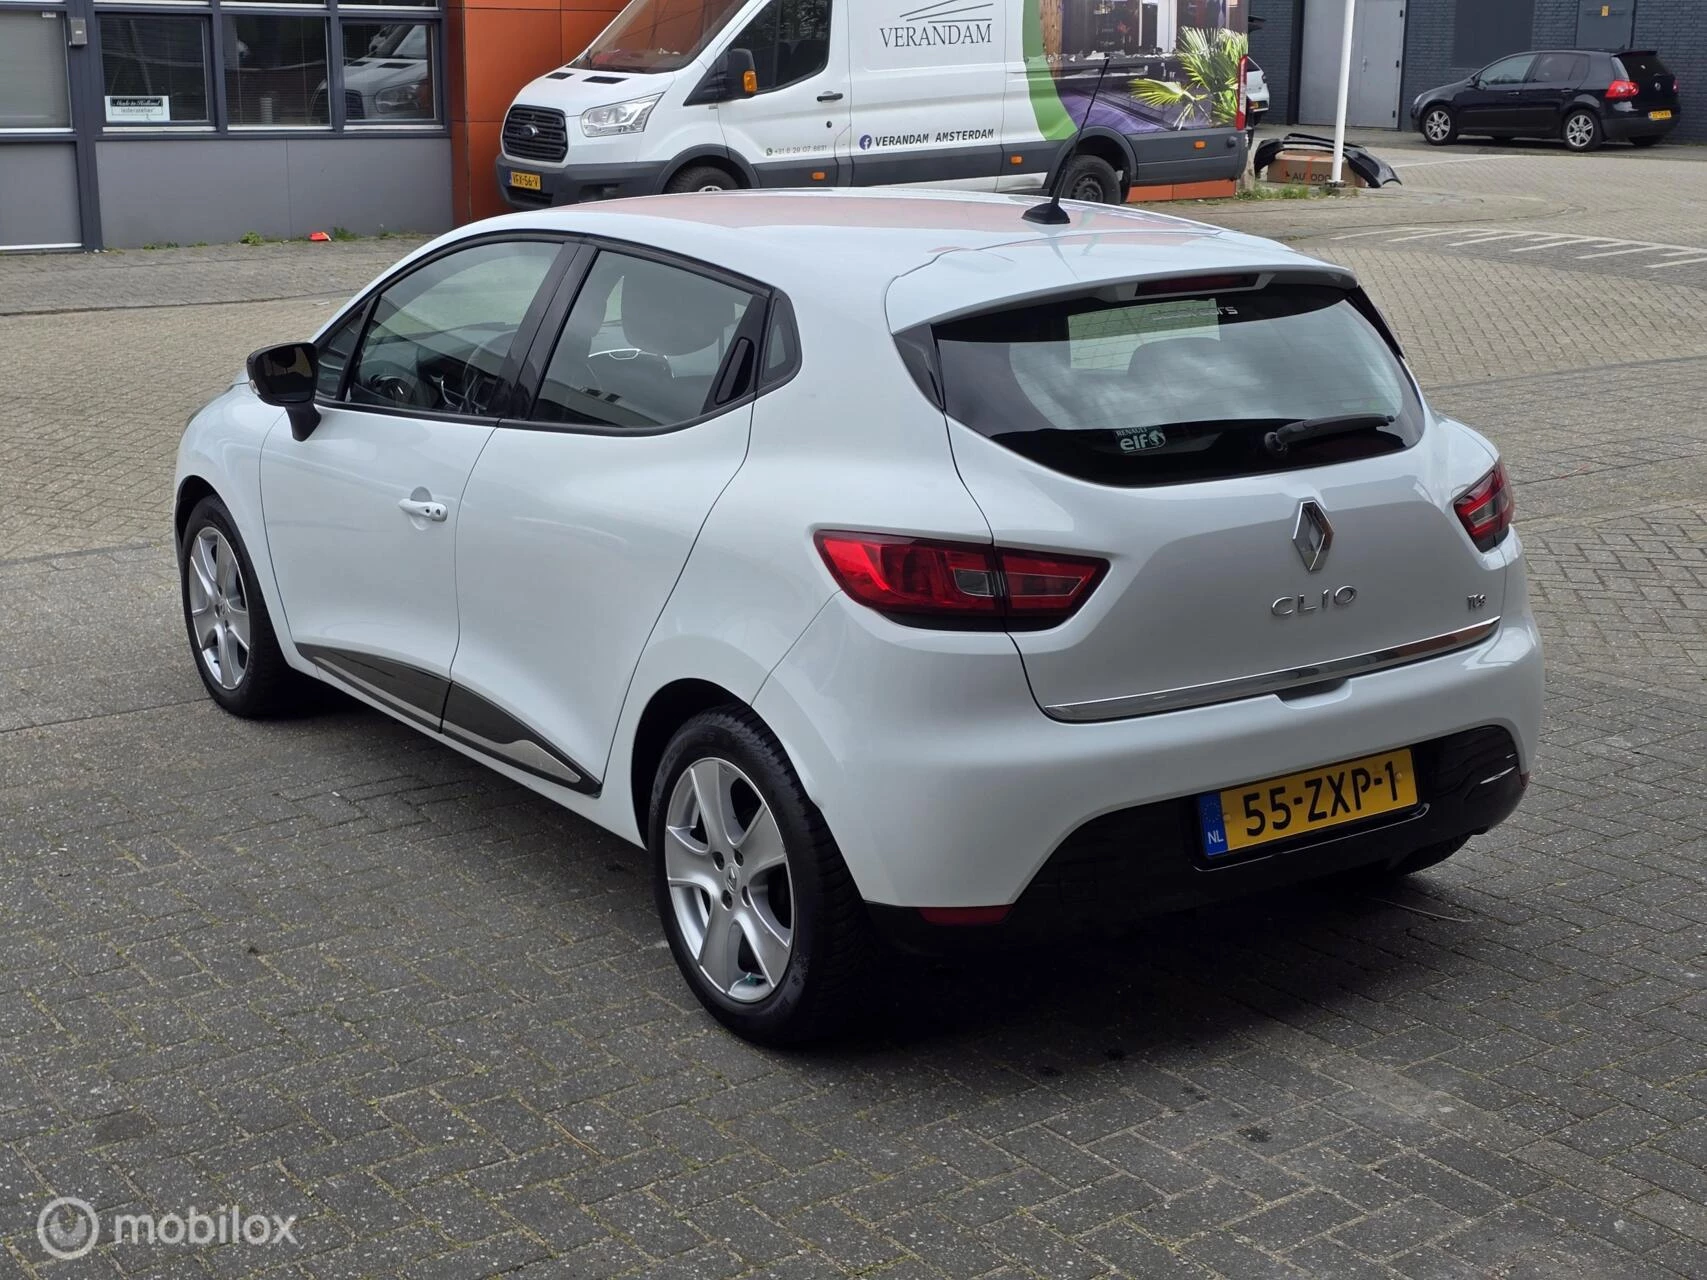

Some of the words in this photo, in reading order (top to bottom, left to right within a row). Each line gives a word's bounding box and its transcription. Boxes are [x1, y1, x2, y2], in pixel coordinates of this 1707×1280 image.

[880, 24, 992, 48] VERANDAM
[875, 133, 929, 147] VERANDAM
[935, 128, 994, 143] AMSTERDAM
[1120, 433, 1148, 451] elf
[1271, 585, 1358, 616] CLIO
[1242, 760, 1399, 837] 55-ZXP-1
[1208, 831, 1224, 845] NL
